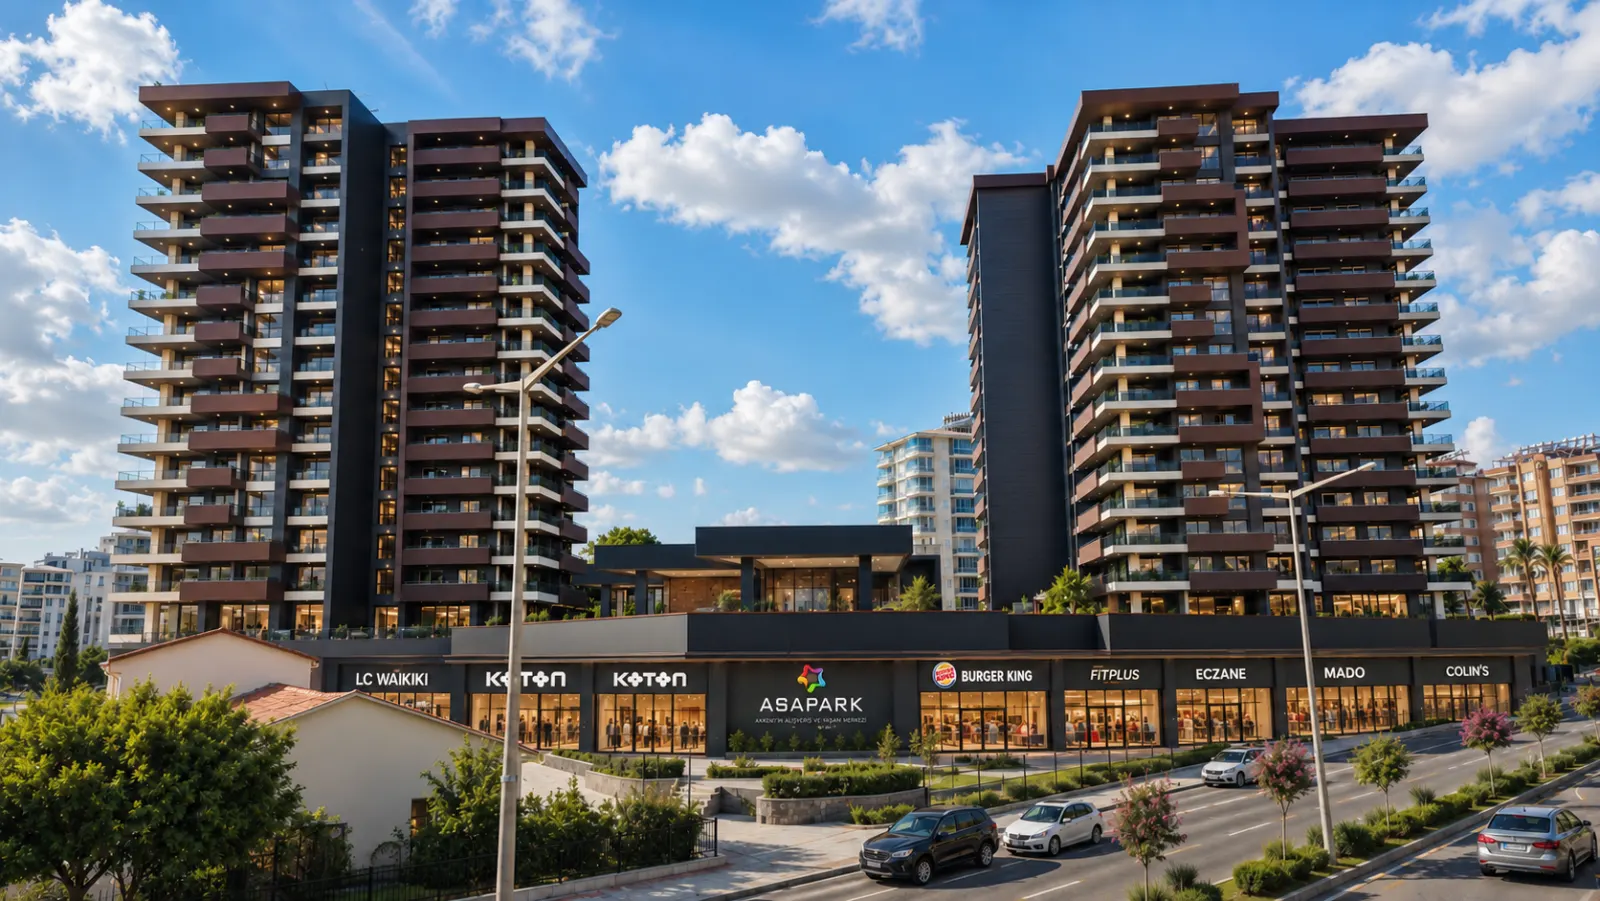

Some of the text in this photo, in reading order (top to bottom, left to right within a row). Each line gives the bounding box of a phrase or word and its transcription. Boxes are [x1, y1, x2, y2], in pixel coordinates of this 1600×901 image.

[961, 671, 1004, 682] BURGER
[1007, 670, 1033, 682] KING
[1090, 668, 1140, 681] FITPLUS
[1195, 667, 1247, 681] ECZANE
[1324, 666, 1366, 680] MADO
[1446, 665, 1490, 678] COLIN'S
[355, 671, 429, 687] LC WAIKIKI
[759, 697, 863, 712] ASAPARK
